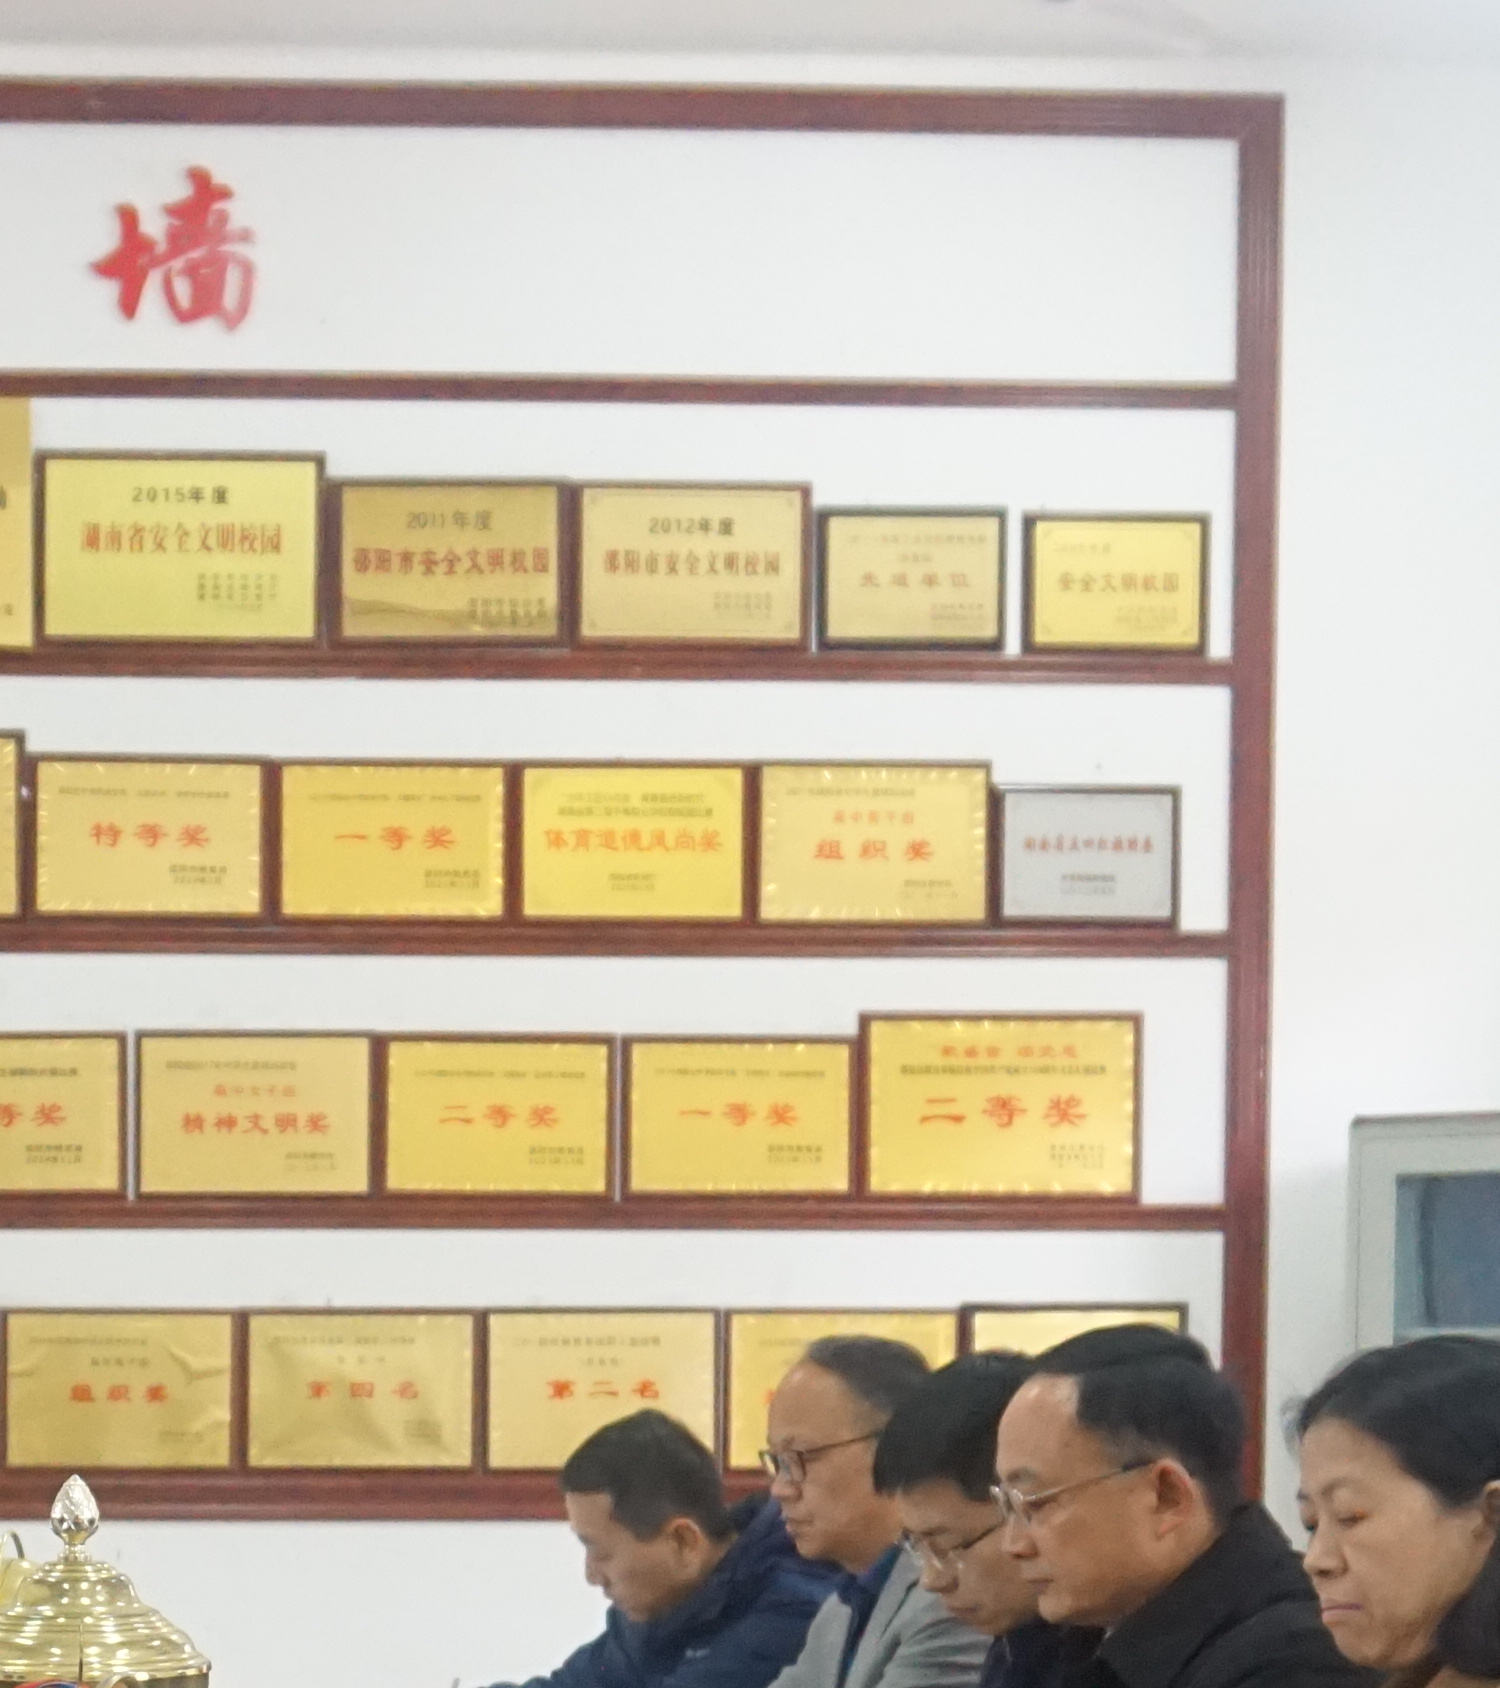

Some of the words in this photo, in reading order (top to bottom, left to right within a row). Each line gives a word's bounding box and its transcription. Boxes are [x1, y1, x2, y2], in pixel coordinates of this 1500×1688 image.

[132, 486, 229, 505] 2015年度
[81, 521, 283, 556] 湖南省安全文明校园
[648, 516, 736, 537] 2012年度
[352, 546, 550, 576] 邵阳市安全文明校园
[603, 549, 781, 577] 邵阳市安全文明校园
[91, 822, 211, 848] 特等奖
[334, 824, 458, 850] 一等奖
[813, 837, 935, 861] 组织奖
[181, 1112, 331, 1135] 精神文明奖
[438, 1104, 561, 1128] 二等奖
[680, 1103, 799, 1128] 一等奖
[920, 1094, 1088, 1129] 二等奖
[547, 1379, 661, 1400] 第二名
